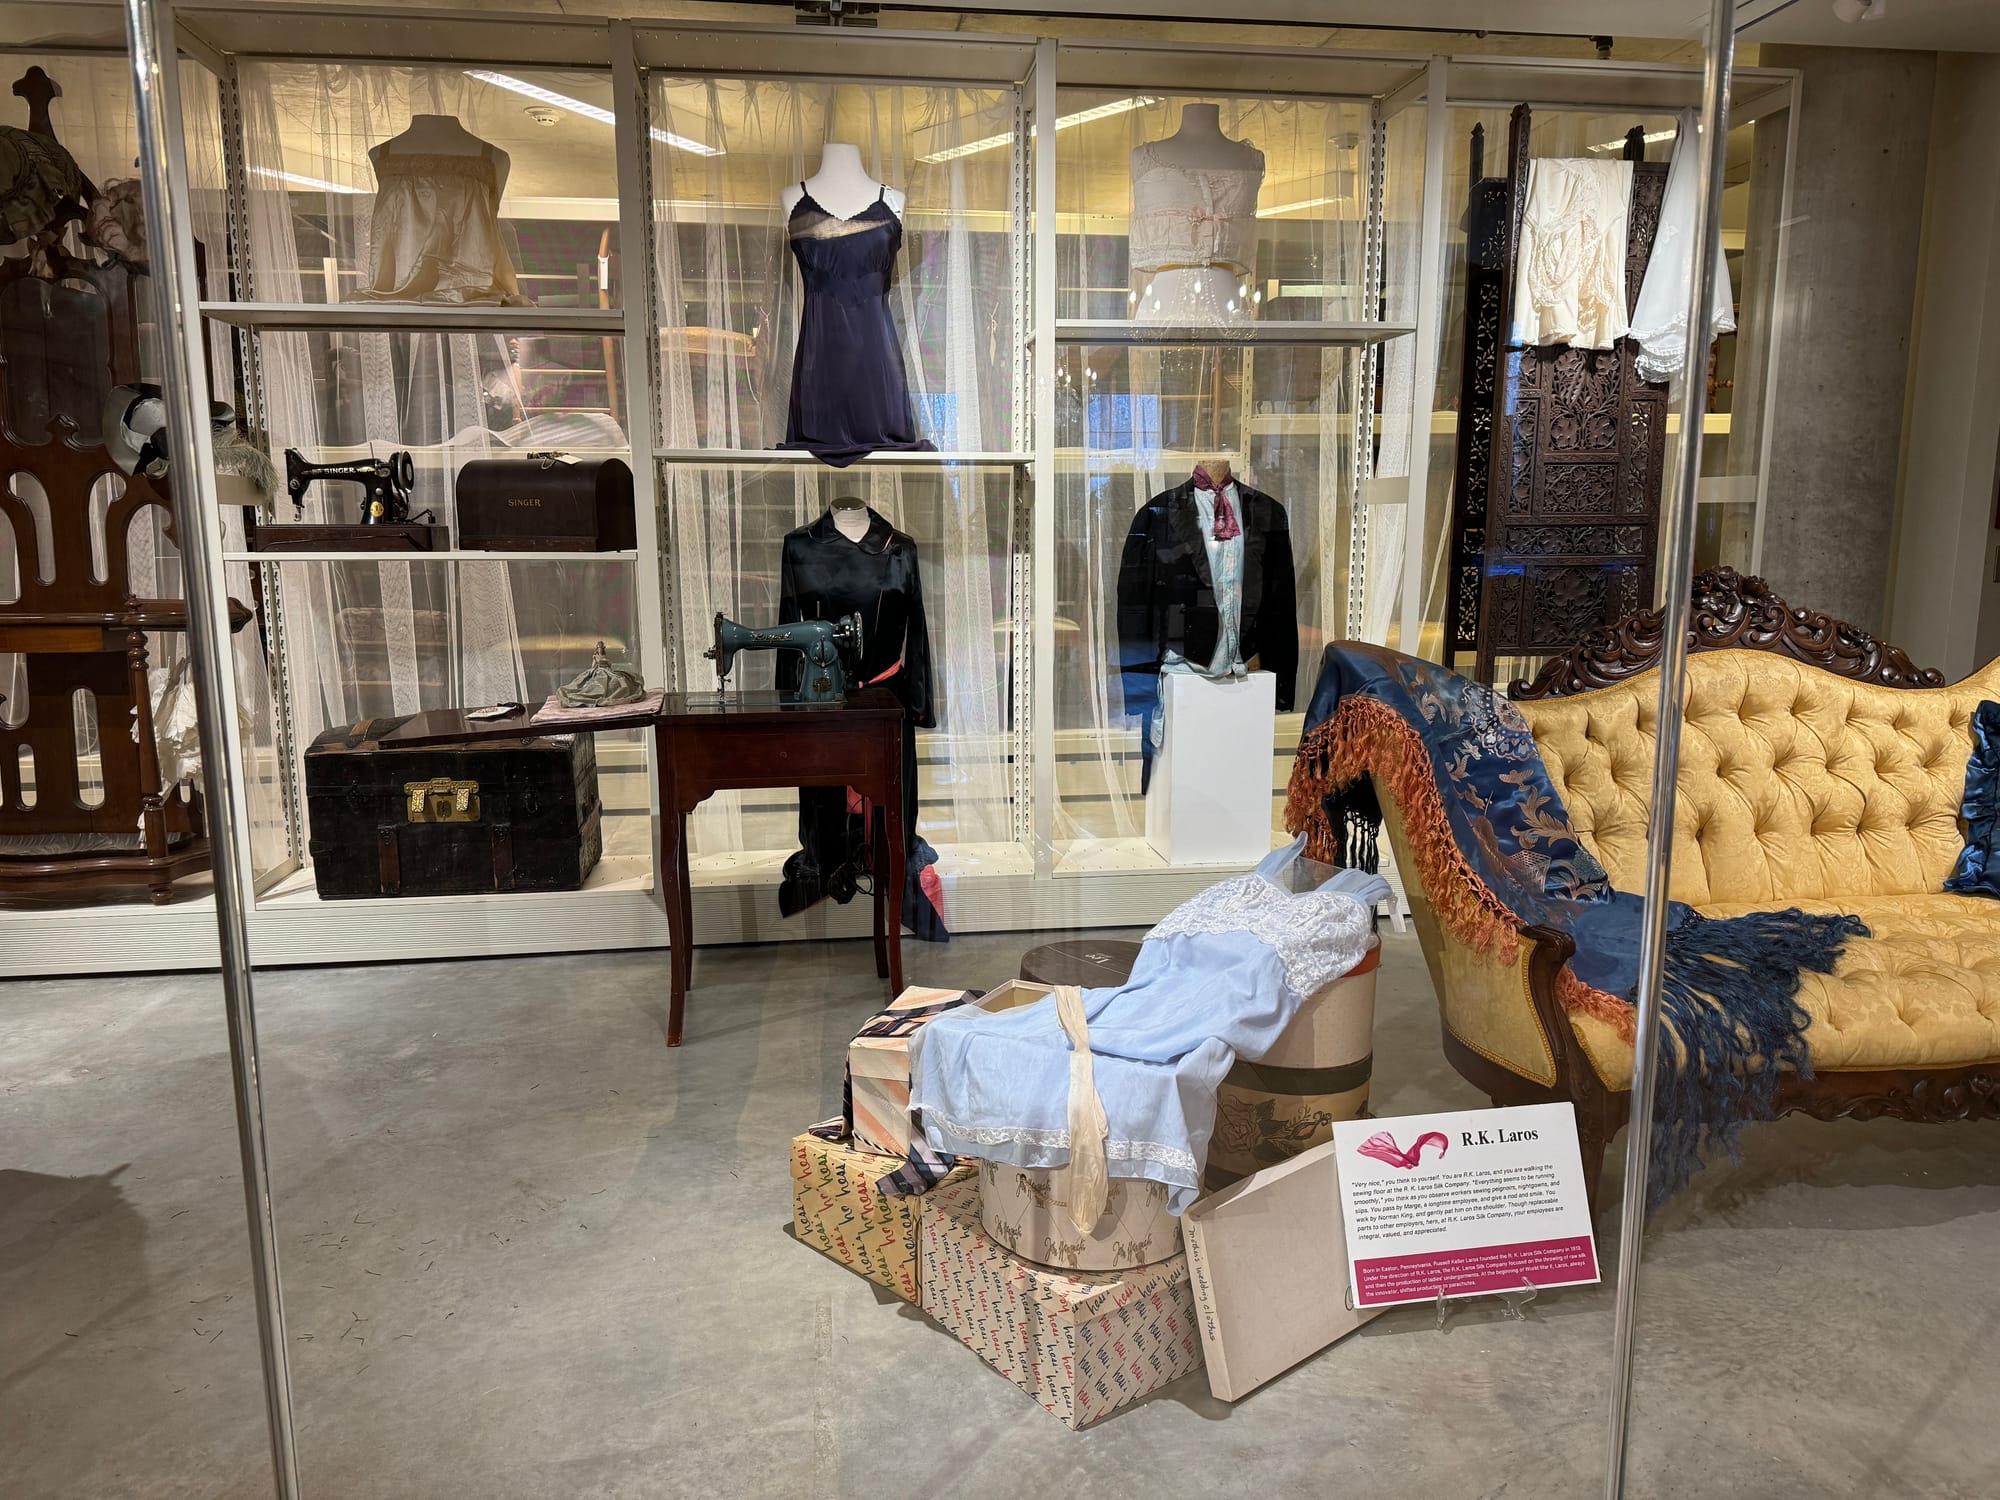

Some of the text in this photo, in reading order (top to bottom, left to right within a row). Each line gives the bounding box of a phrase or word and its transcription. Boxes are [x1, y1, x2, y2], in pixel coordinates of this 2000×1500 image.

[324, 467, 356, 475] SINGER
[508, 498, 541, 508] SINGER
[1461, 1128, 1539, 1147] R.K. Laros
[1523, 1165, 1543, 1173] walking
[1352, 1189, 1372, 1198] sewing
[1534, 1172, 1555, 1181] running
[1428, 1190, 1449, 1198] observe
[1450, 1188, 1471, 1196] workers
[1472, 1186, 1491, 1195] sewing
[1377, 1212, 1399, 1220] Norman
[1426, 1208, 1443, 1217] gently
[1443, 1207, 1453, 1215] pat
[1507, 1200, 1527, 1209] Though
[1528, 1197, 1558, 1207] replaceable
[1395, 1203, 1403, 1211] by
[1427, 1199, 1451, 1208] longtime
[1491, 1194, 1502, 1202] give
[1356, 1224, 1371, 1232] parts
[1526, 1206, 1554, 1216] employees
[1196, 1267, 1209, 1302] wedding
